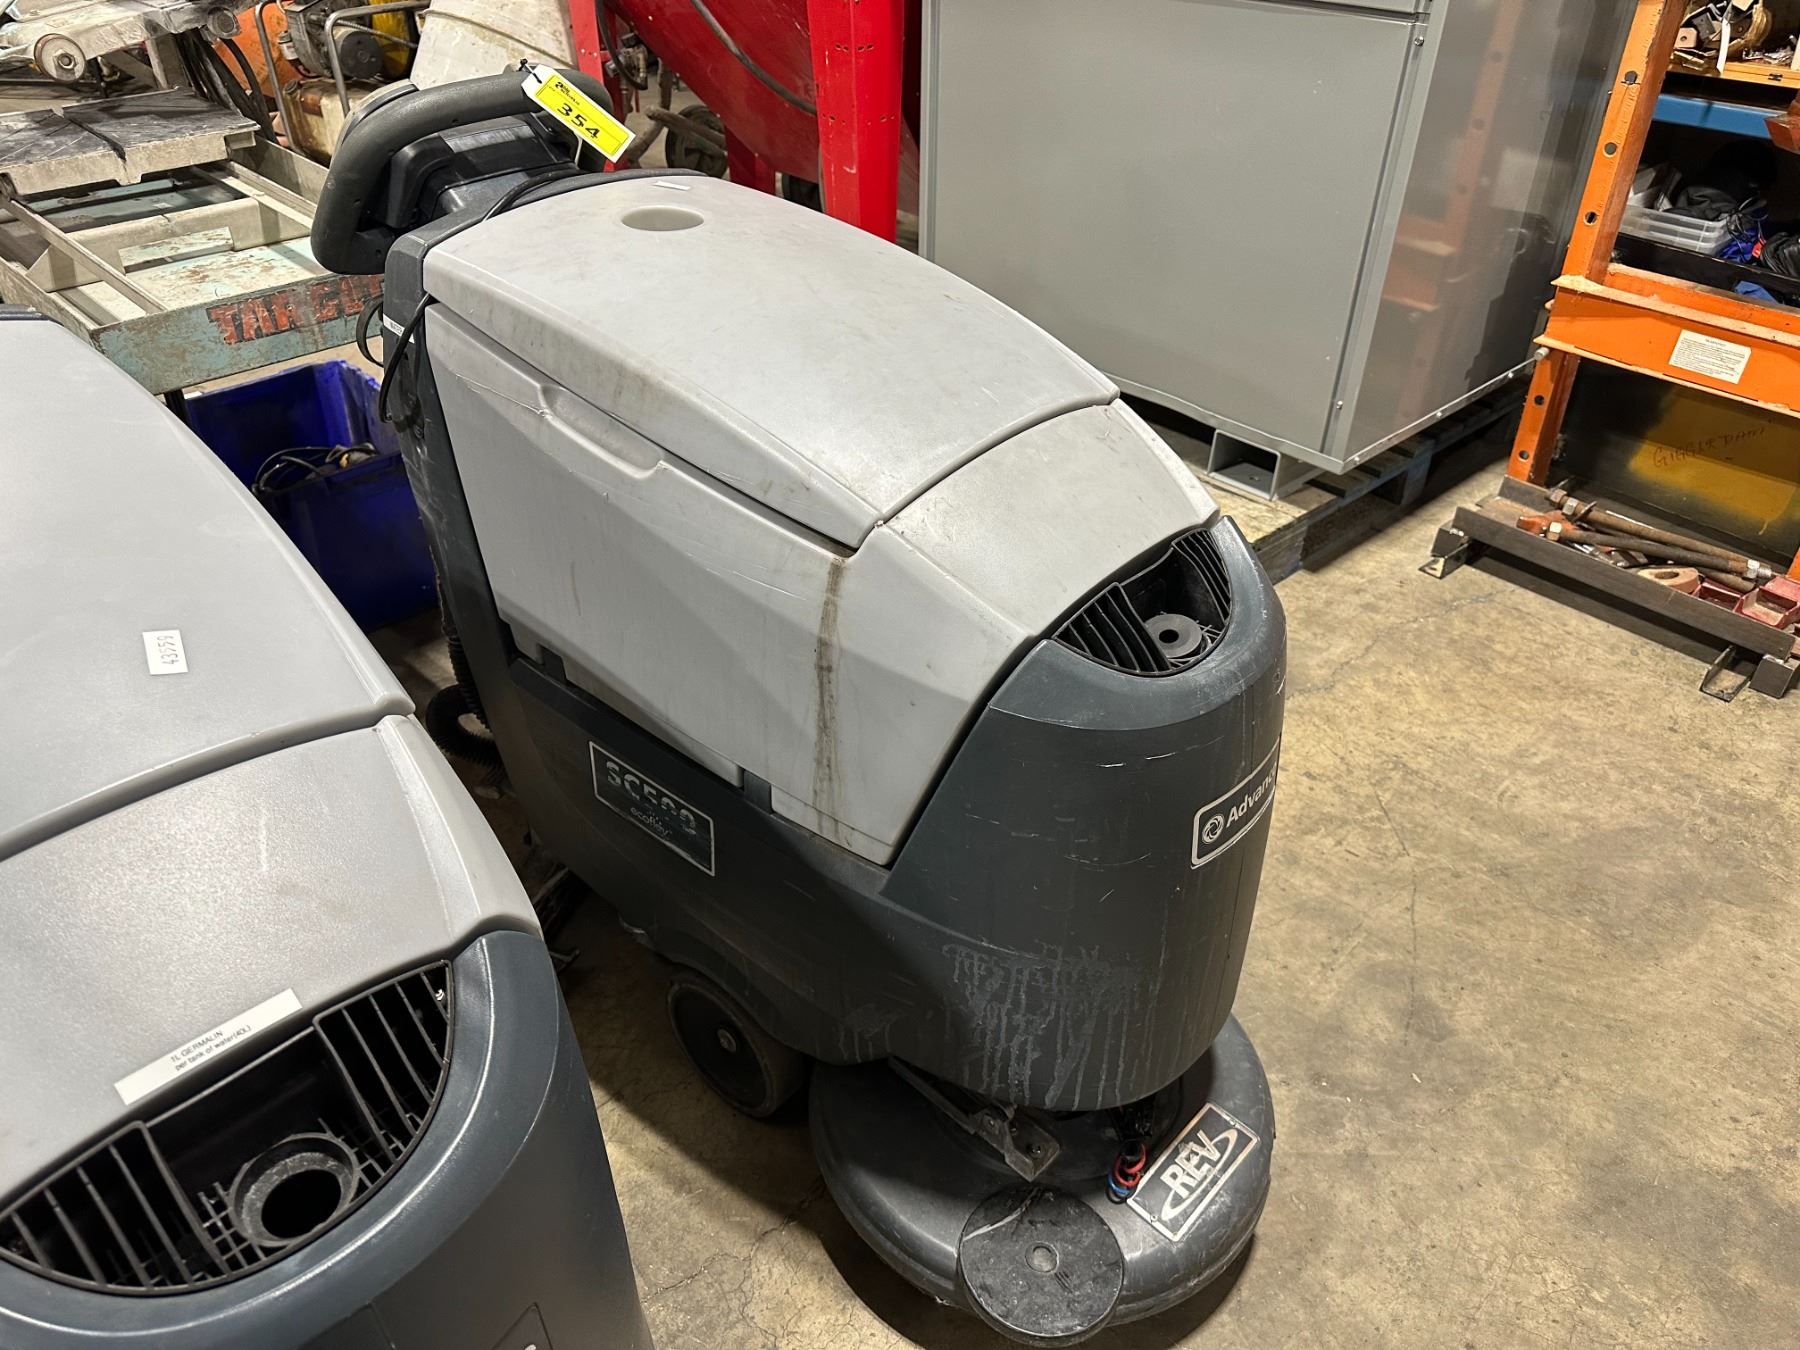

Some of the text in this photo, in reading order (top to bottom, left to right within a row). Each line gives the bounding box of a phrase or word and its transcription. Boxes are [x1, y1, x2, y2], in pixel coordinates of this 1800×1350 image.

[557, 102, 600, 139] 354
[175, 1060, 188, 1072] per
[188, 1050, 205, 1063] tank
[205, 1044, 214, 1054] of
[1160, 1130, 1221, 1199] REV
